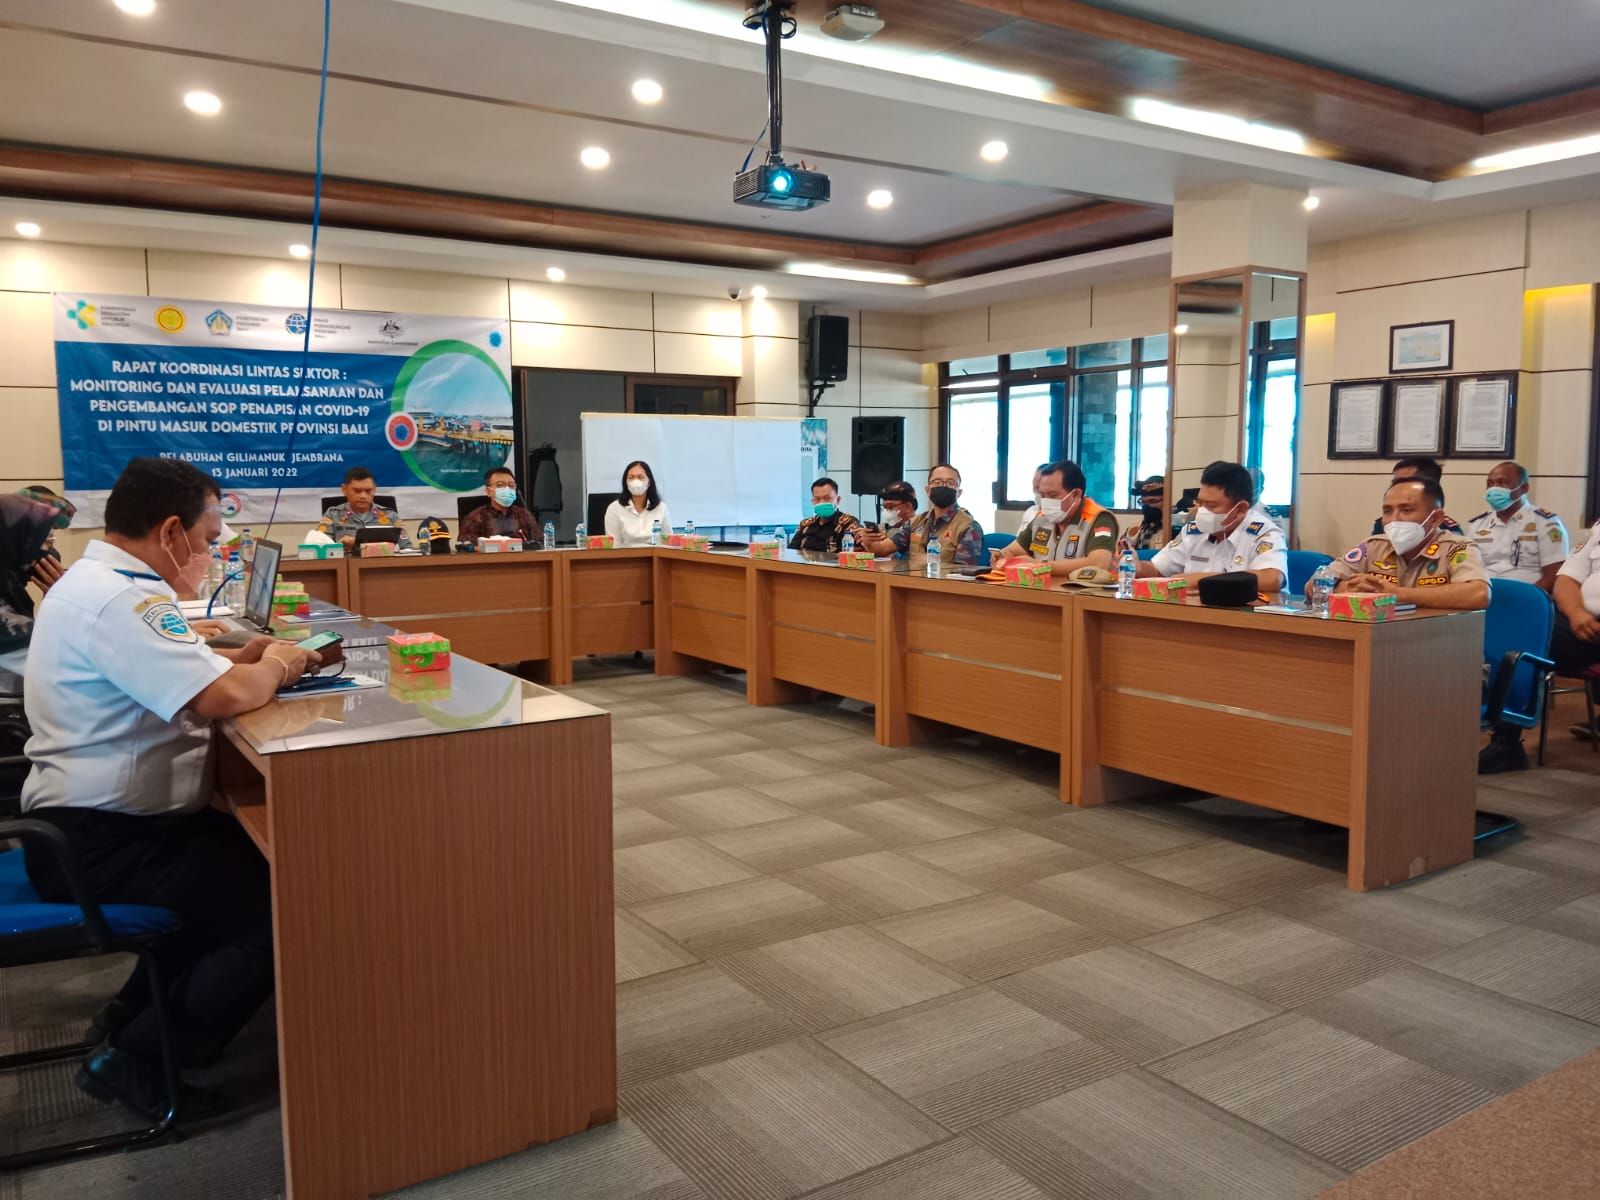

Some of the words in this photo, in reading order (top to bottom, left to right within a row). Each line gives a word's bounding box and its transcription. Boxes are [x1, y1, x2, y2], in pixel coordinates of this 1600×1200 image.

[112, 360, 156, 373] RAPAT
[159, 361, 243, 376] KOORDINASI
[246, 364, 290, 378] LINTAS
[70, 379, 164, 393] MONITORING
[167, 382, 196, 394] DAN
[199, 382, 261, 396] EVALUASI
[358, 387, 384, 400] DAN
[89, 399, 207, 414] PENGEMBANGAN
[210, 401, 237, 414] SOP
[314, 404, 370, 417] COVID-19
[97, 419, 112, 432] DI
[116, 420, 157, 432] PINTU
[159, 420, 209, 433] MASUK
[211, 421, 278, 434] DOMESTIK
[341, 423, 369, 435] BALI
[159, 452, 223, 462] PELABUHAN
[226, 452, 286, 462] GILIMANUK
[291, 453, 344, 464] JEMBRANA
[225, 467, 269, 479] JANUARI
[271, 467, 298, 477] 2022
